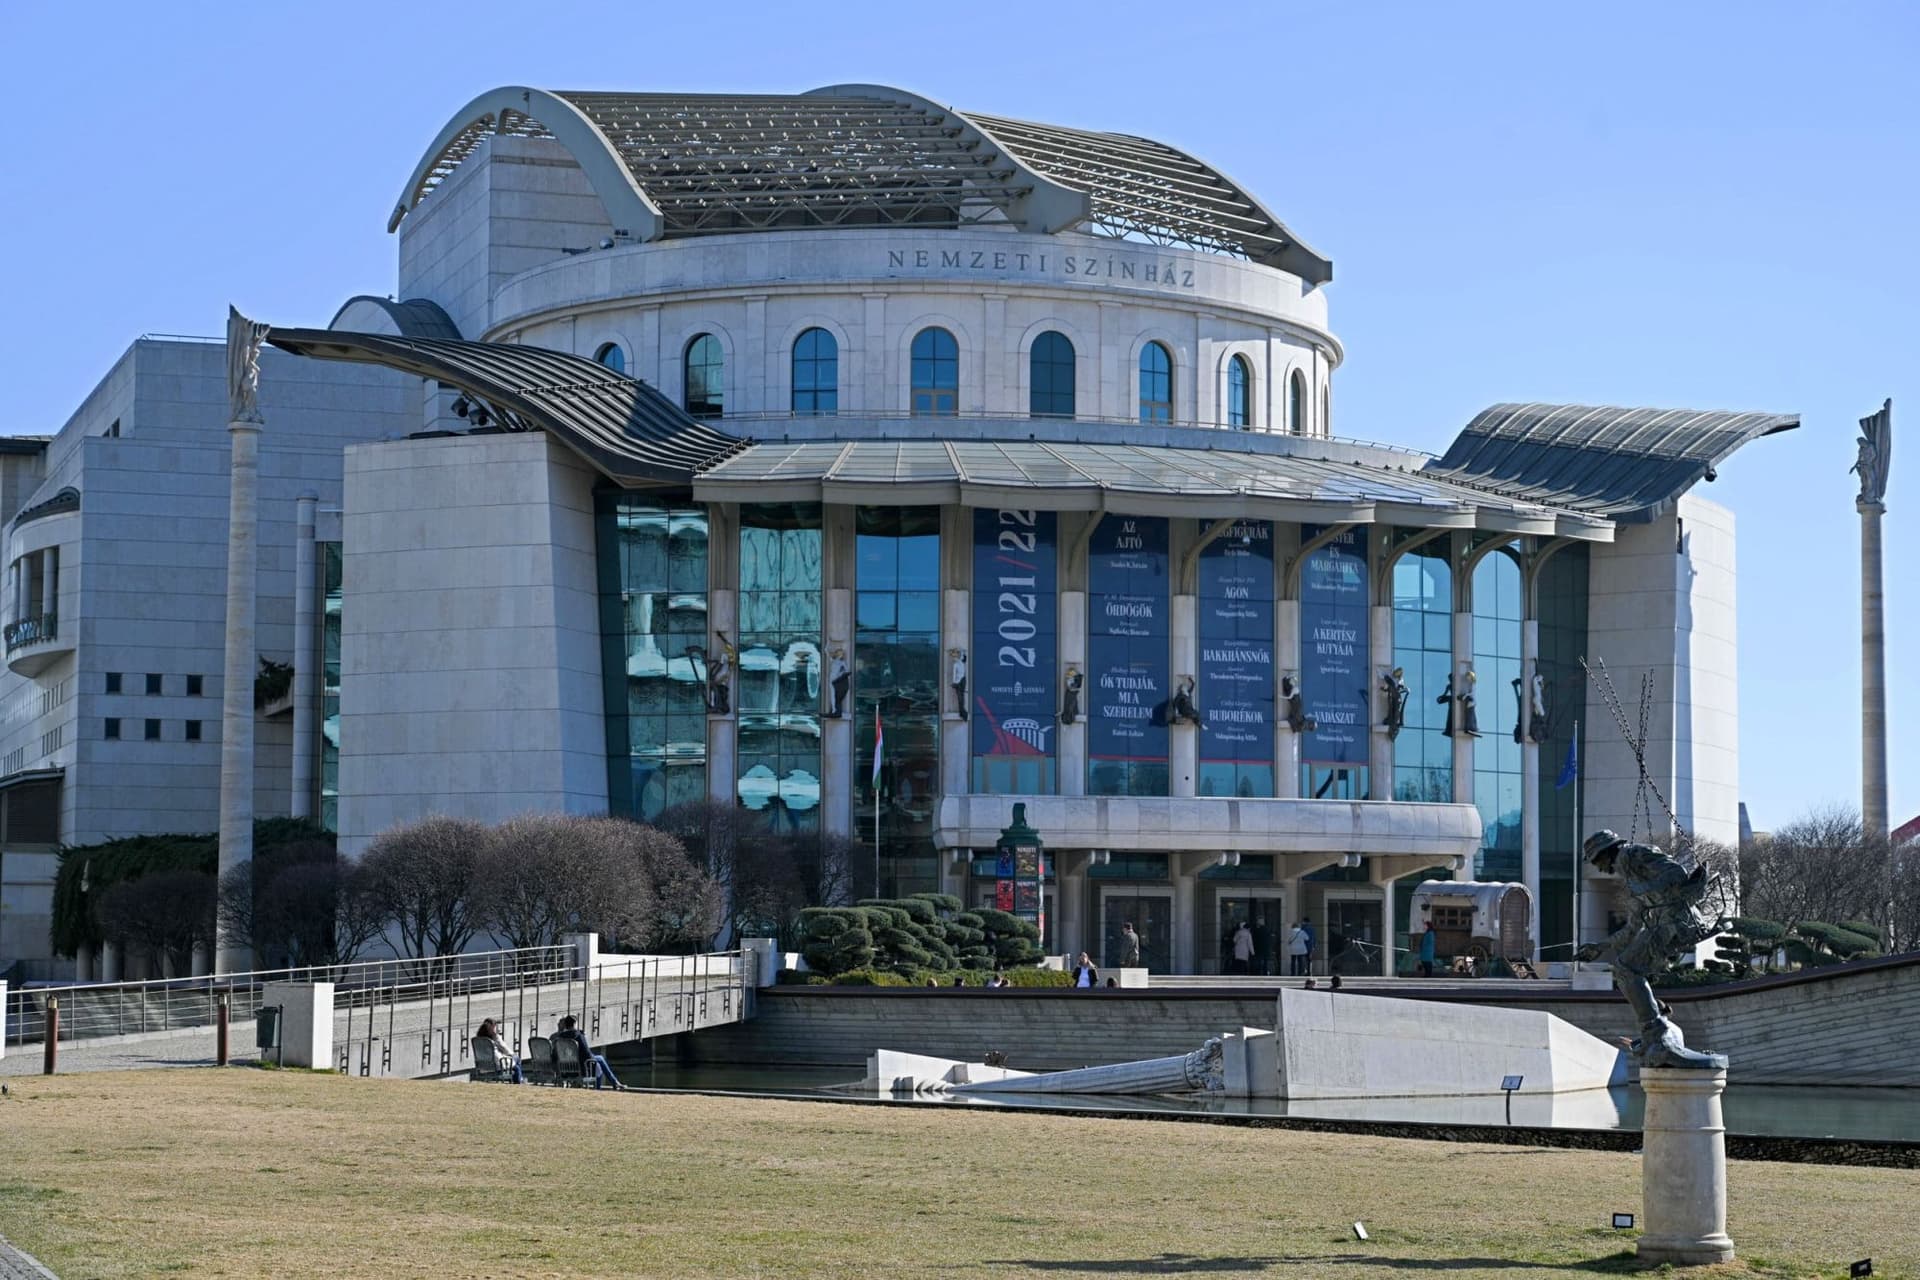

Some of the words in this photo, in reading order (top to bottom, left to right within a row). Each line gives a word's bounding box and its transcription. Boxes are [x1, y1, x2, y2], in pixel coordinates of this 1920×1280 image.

[888, 250, 1046, 273] NEMZETI
[1064, 254, 1195, 288] SZÍNHÁZ
[1115, 533, 1143, 549] AJTÓ
[1312, 627, 1319, 640] A
[1320, 626, 1356, 641] KERTÉSZ
[1316, 641, 1353, 656] KUTYÁJA
[1115, 675, 1157, 690] TUDJÁK,
[1103, 705, 1153, 719] SZERELEM
[1209, 707, 1264, 723] BUBORÉKOK
